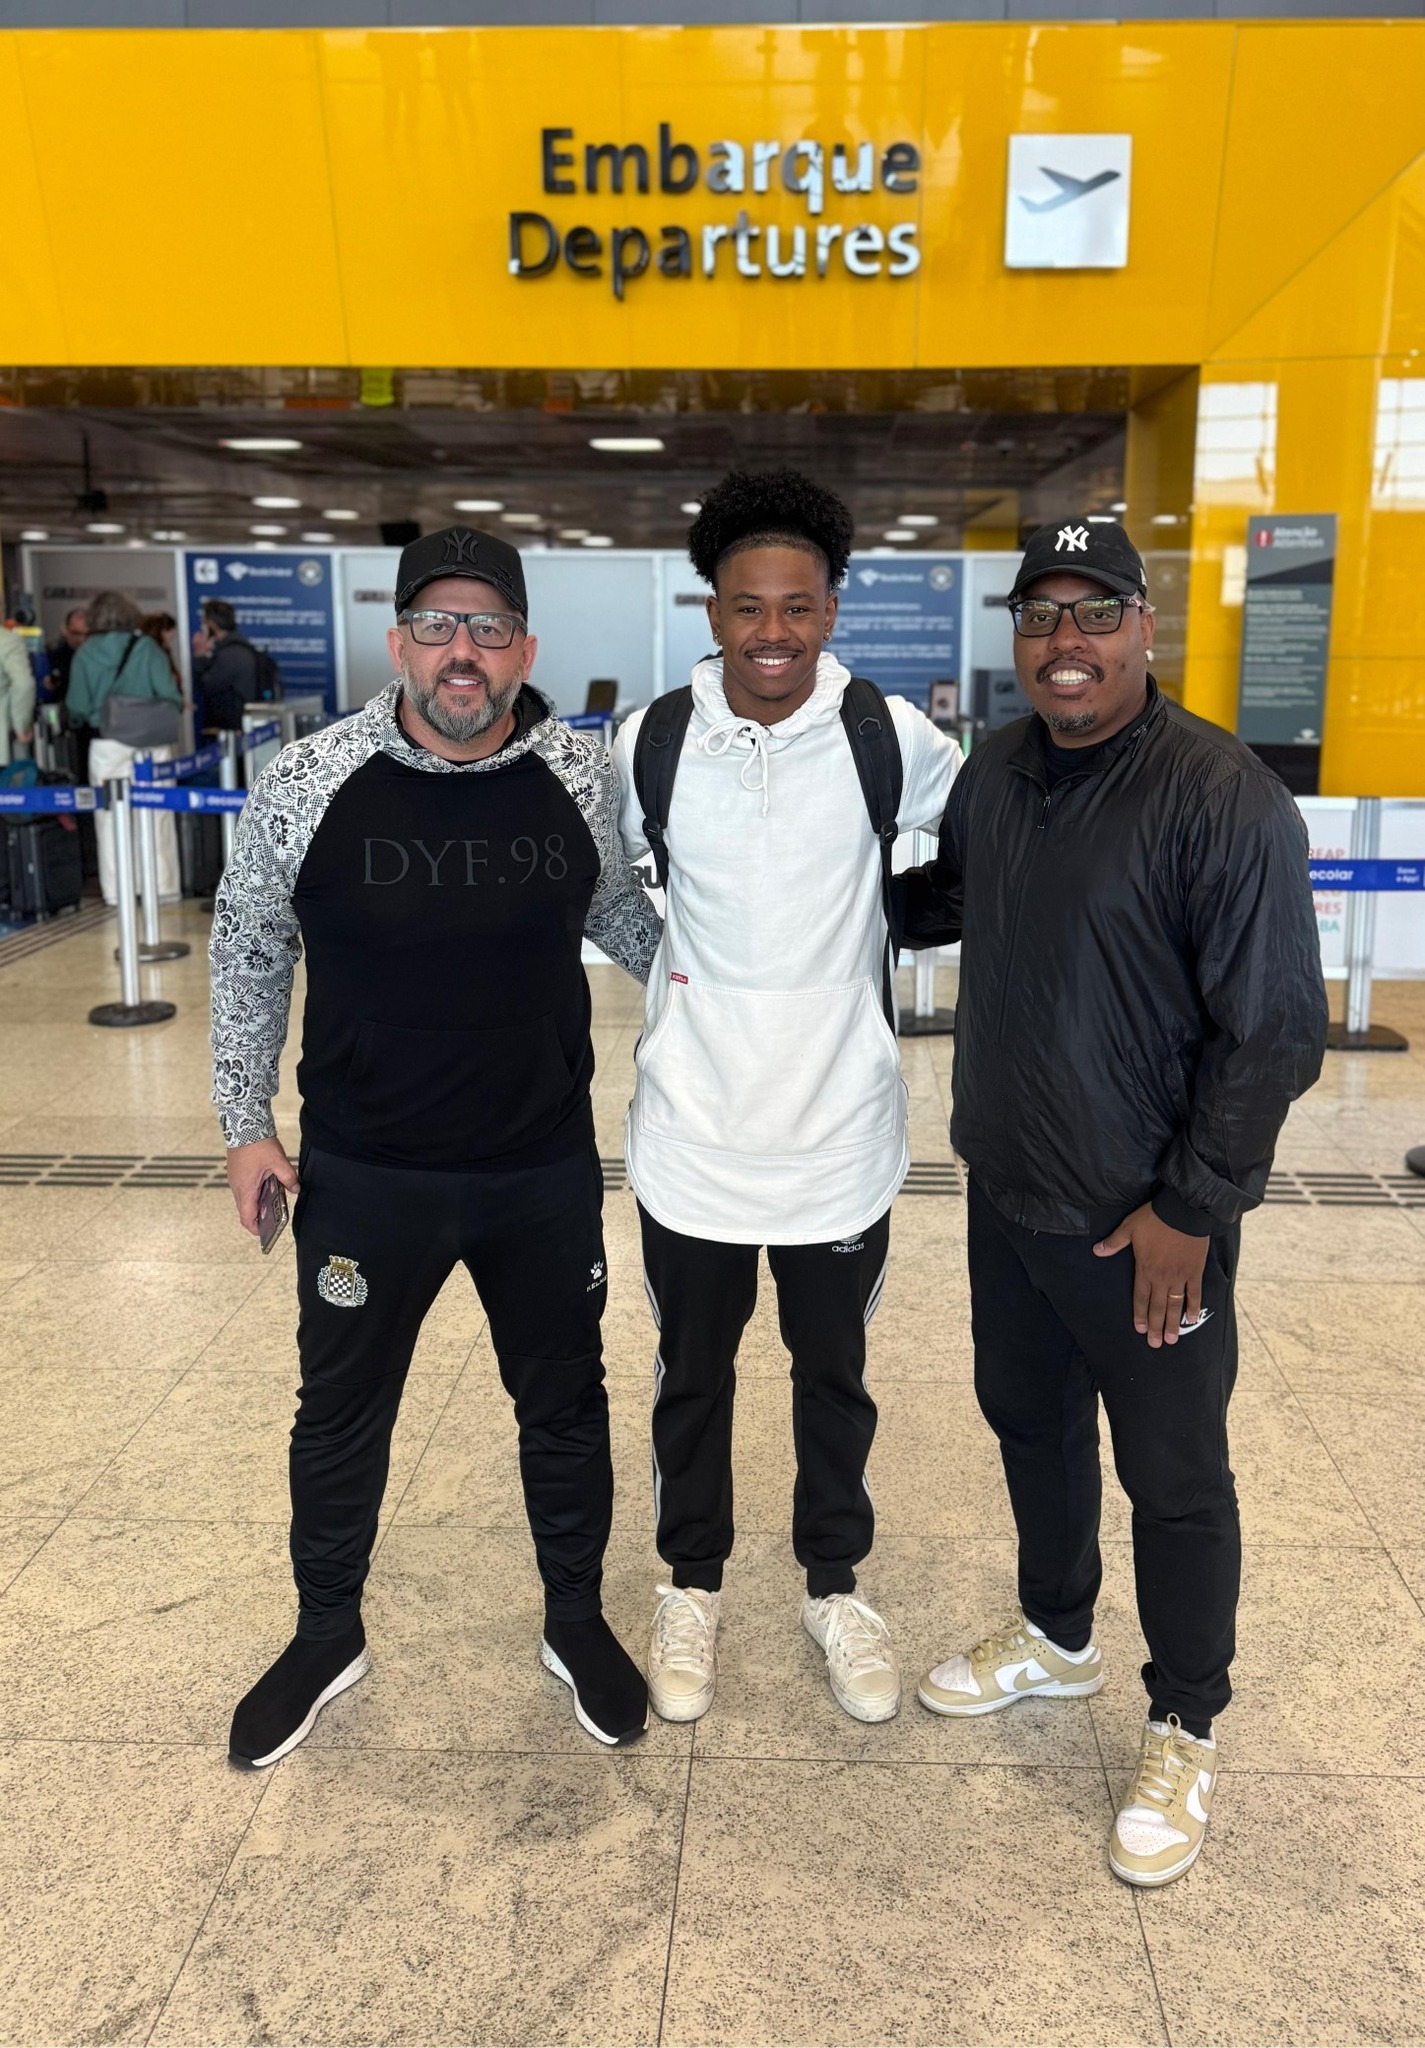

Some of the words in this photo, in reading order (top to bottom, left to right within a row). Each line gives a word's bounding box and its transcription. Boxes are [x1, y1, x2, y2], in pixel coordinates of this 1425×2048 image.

[541, 122, 922, 215] Embarque
[507, 210, 922, 302] Departures
[442, 530, 479, 563] NY
[1054, 525, 1090, 552] NY
[361, 834, 568, 886] DYF.98
[831, 1242, 865, 1253] adidas
